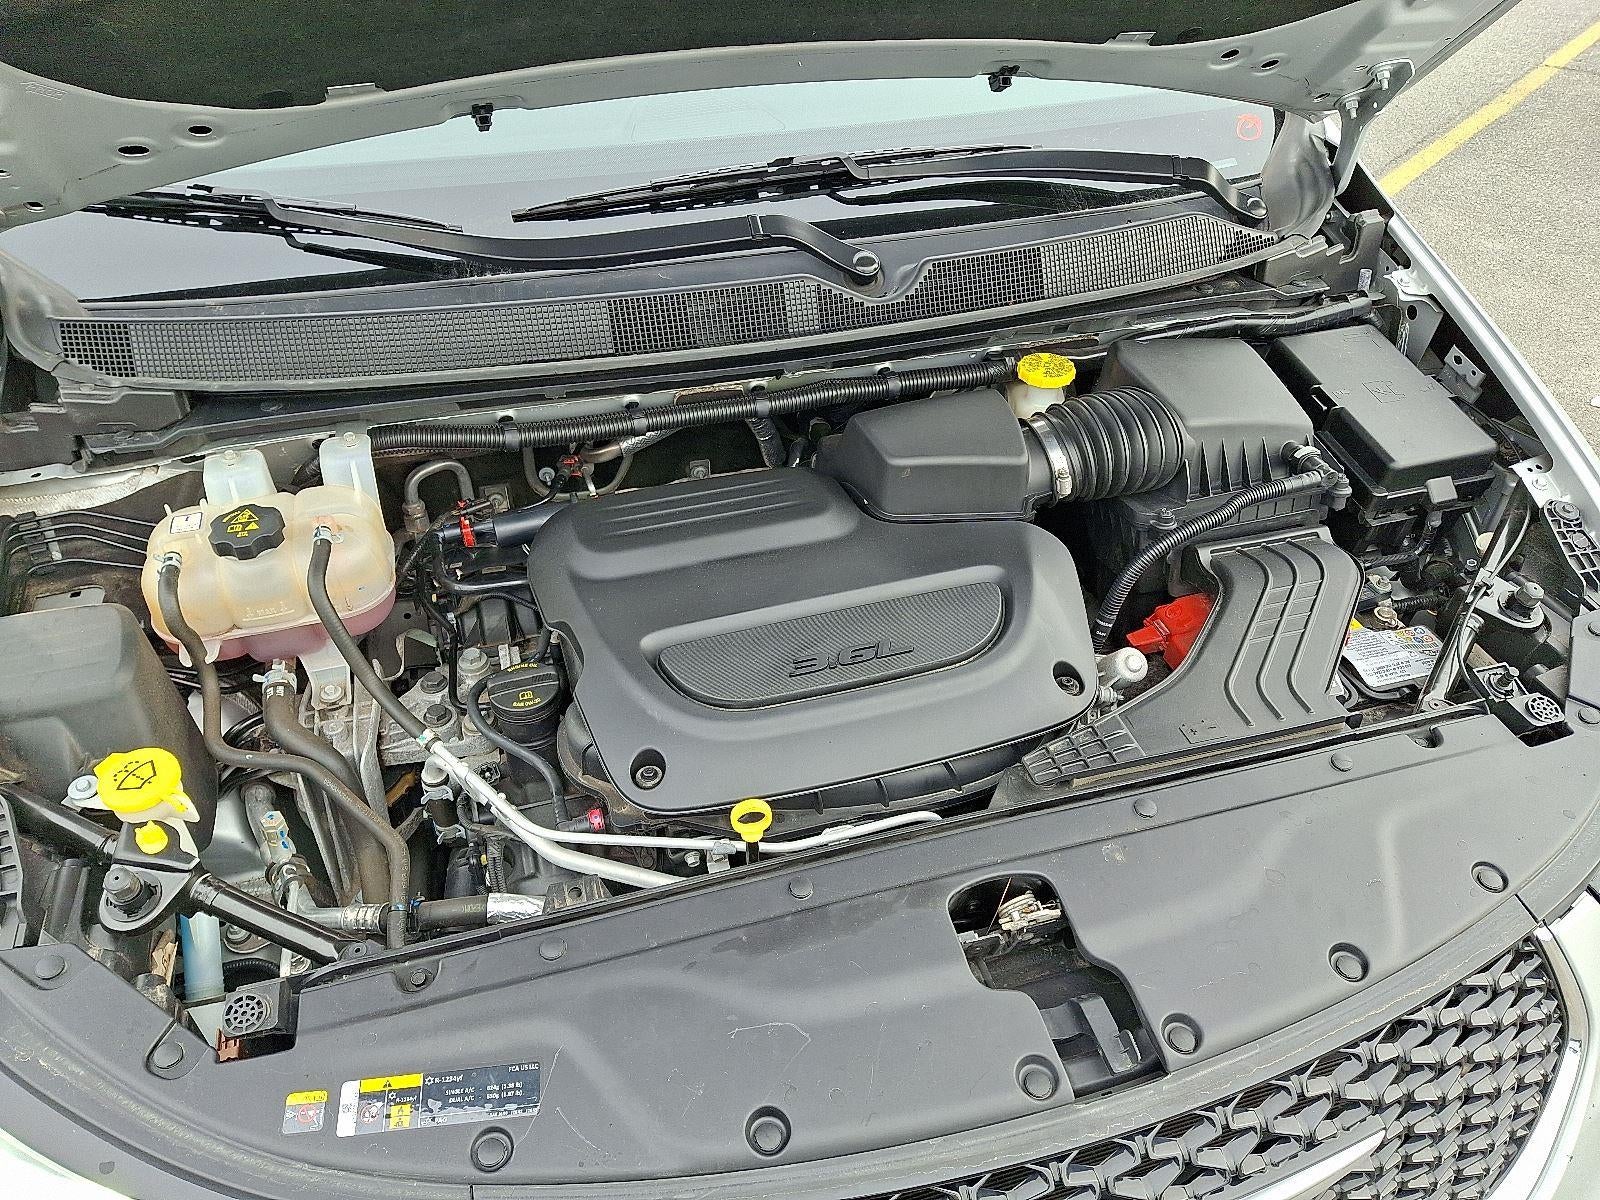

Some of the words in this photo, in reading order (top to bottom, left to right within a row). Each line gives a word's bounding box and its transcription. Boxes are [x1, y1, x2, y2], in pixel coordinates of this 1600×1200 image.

[788, 638, 915, 678] 3.6L
[508, 1065, 520, 1073] FCA
[434, 1074, 463, 1084] R-1234yf
